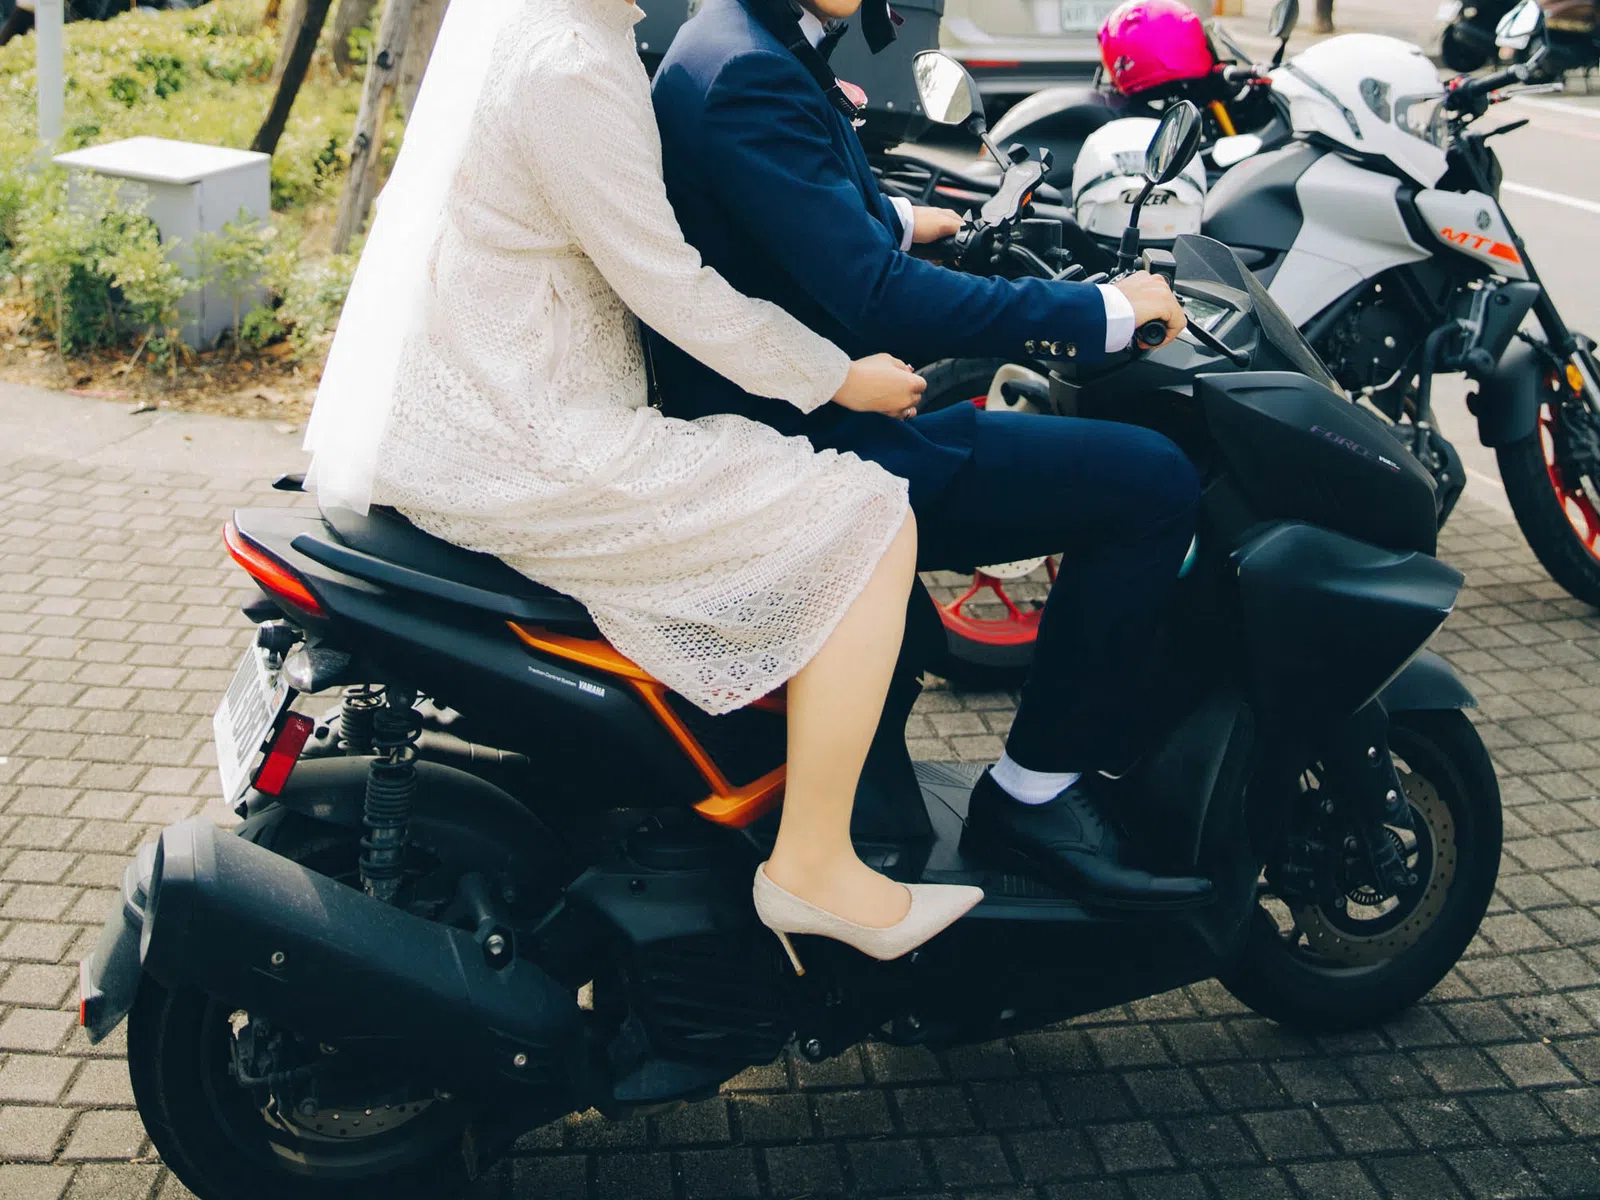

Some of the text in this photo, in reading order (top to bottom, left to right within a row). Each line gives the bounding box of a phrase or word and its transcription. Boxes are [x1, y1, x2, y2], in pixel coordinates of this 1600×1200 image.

[1123, 191, 1171, 206] LZER
[1440, 227, 1493, 250] MT
[1310, 425, 1379, 459] FORCE
[579, 680, 605, 698] YAMAHA
